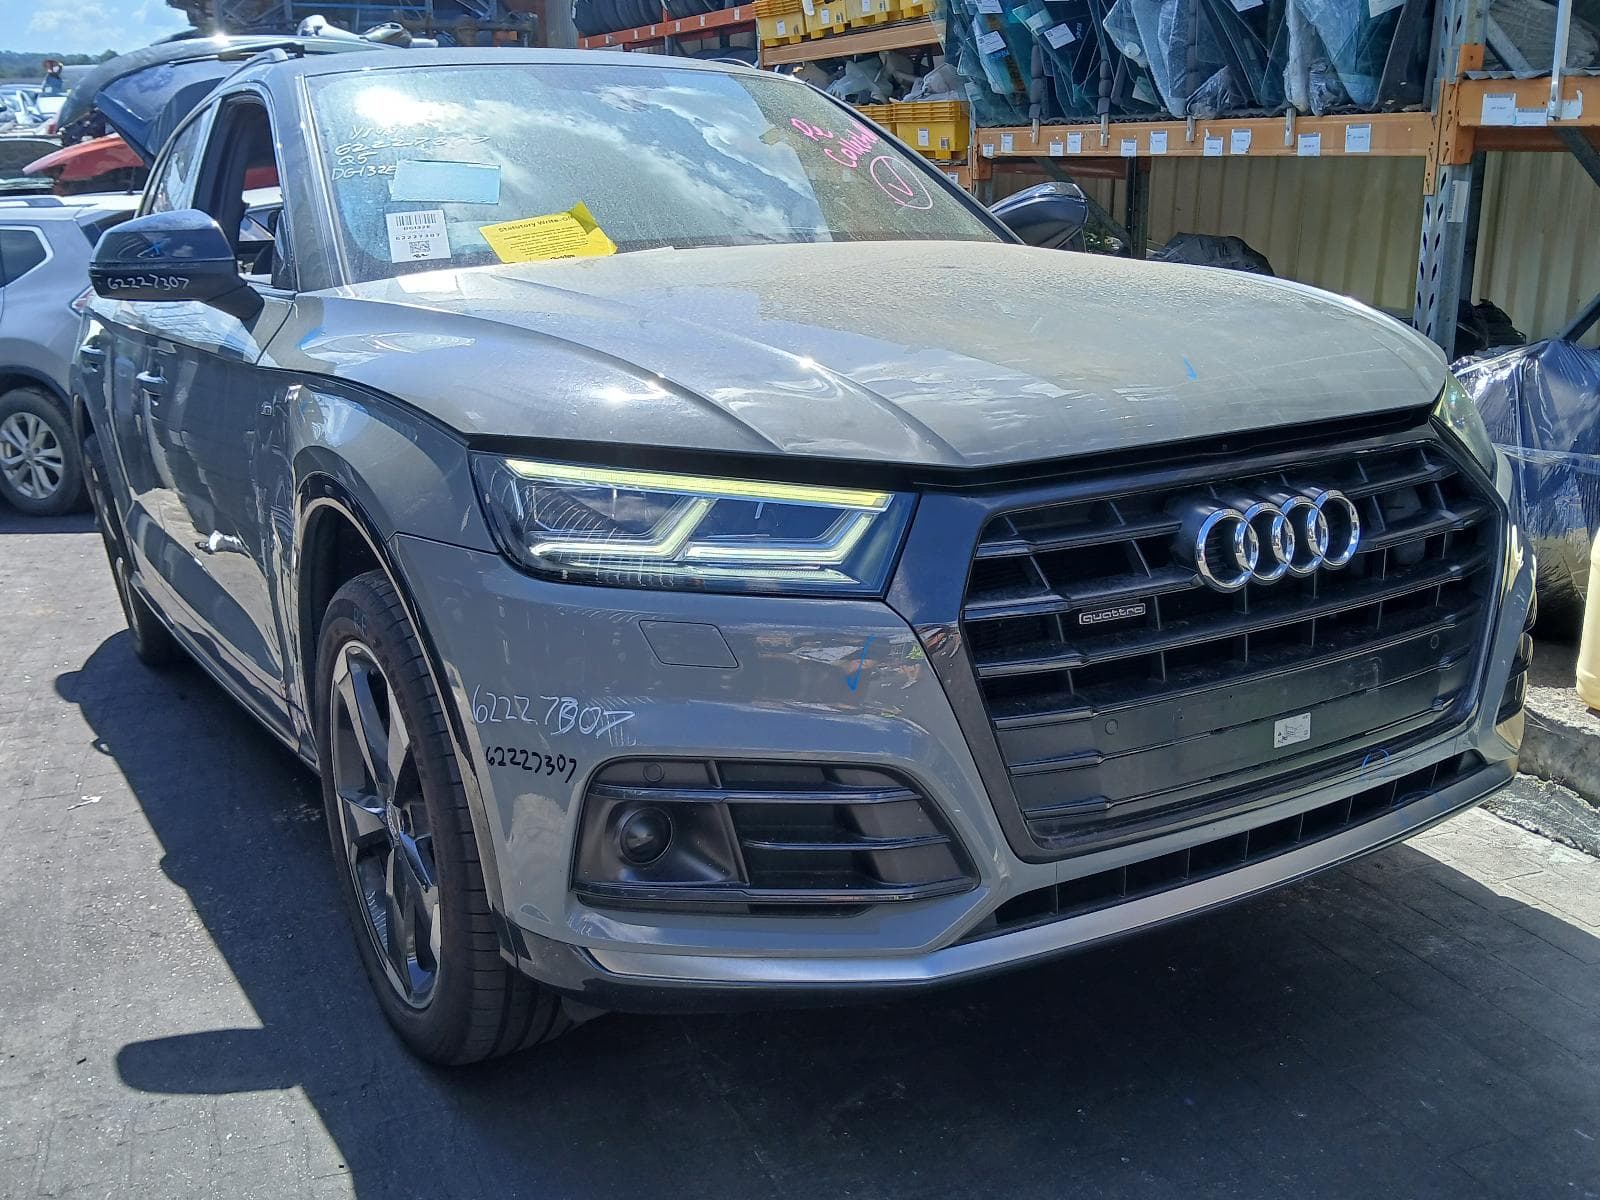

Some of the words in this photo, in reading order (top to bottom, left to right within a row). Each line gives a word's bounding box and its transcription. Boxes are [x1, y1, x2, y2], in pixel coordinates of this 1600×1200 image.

[337, 151, 378, 166] Q5
[498, 221, 536, 233] Statutory
[107, 273, 190, 291] 62227307
[1082, 605, 1144, 624] quattro
[485, 746, 577, 783] 62227307
